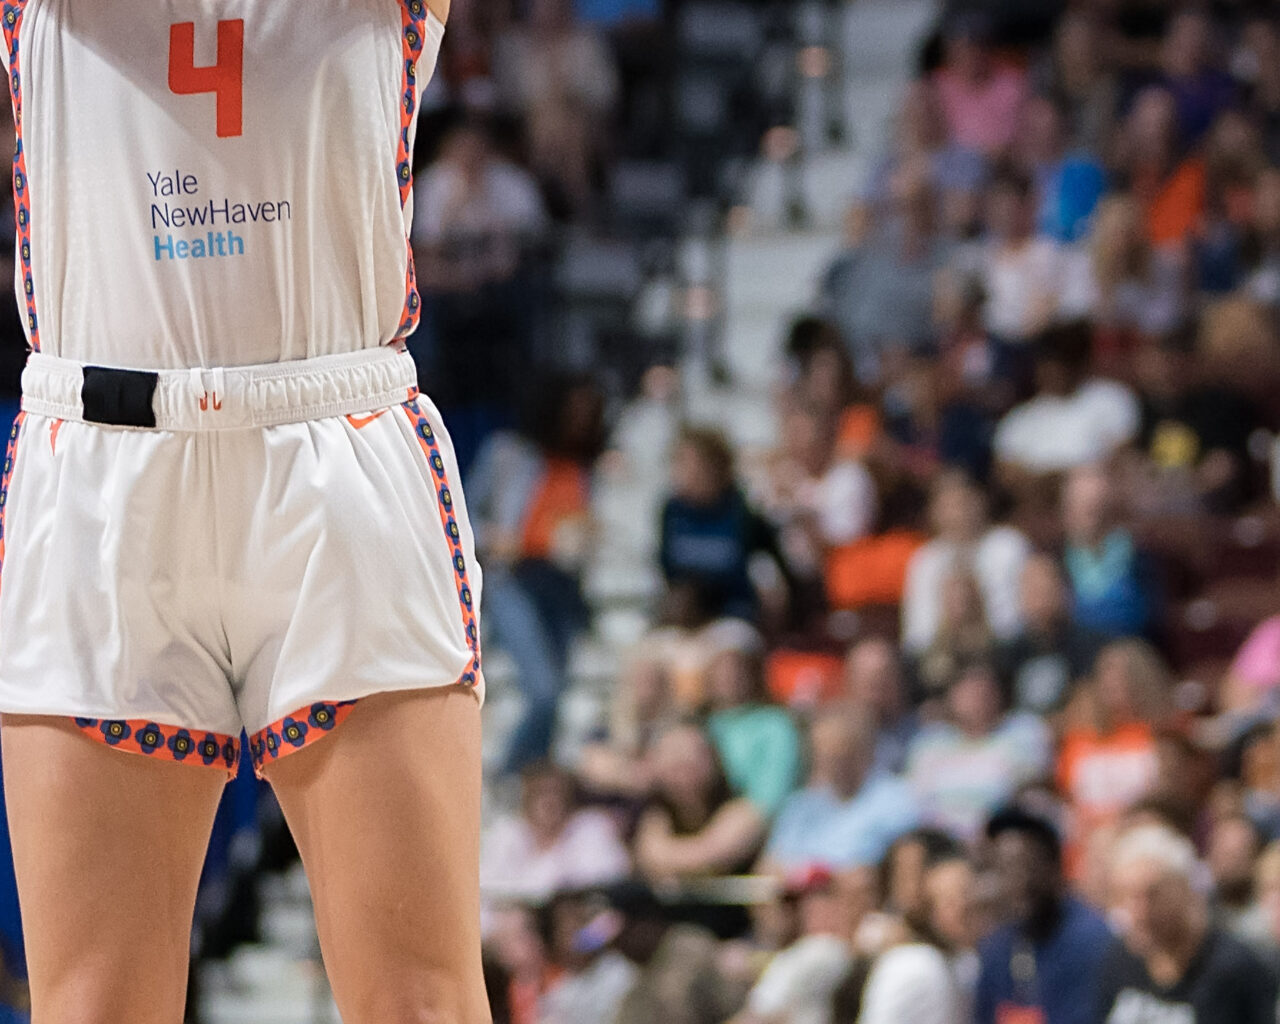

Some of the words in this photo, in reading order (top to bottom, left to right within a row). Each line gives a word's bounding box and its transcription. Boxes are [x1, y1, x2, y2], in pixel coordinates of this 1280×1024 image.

[168, 19, 244, 138] 4
[146, 169, 199, 197] Yale
[151, 198, 291, 229] NewHaven
[153, 230, 245, 261] Health
